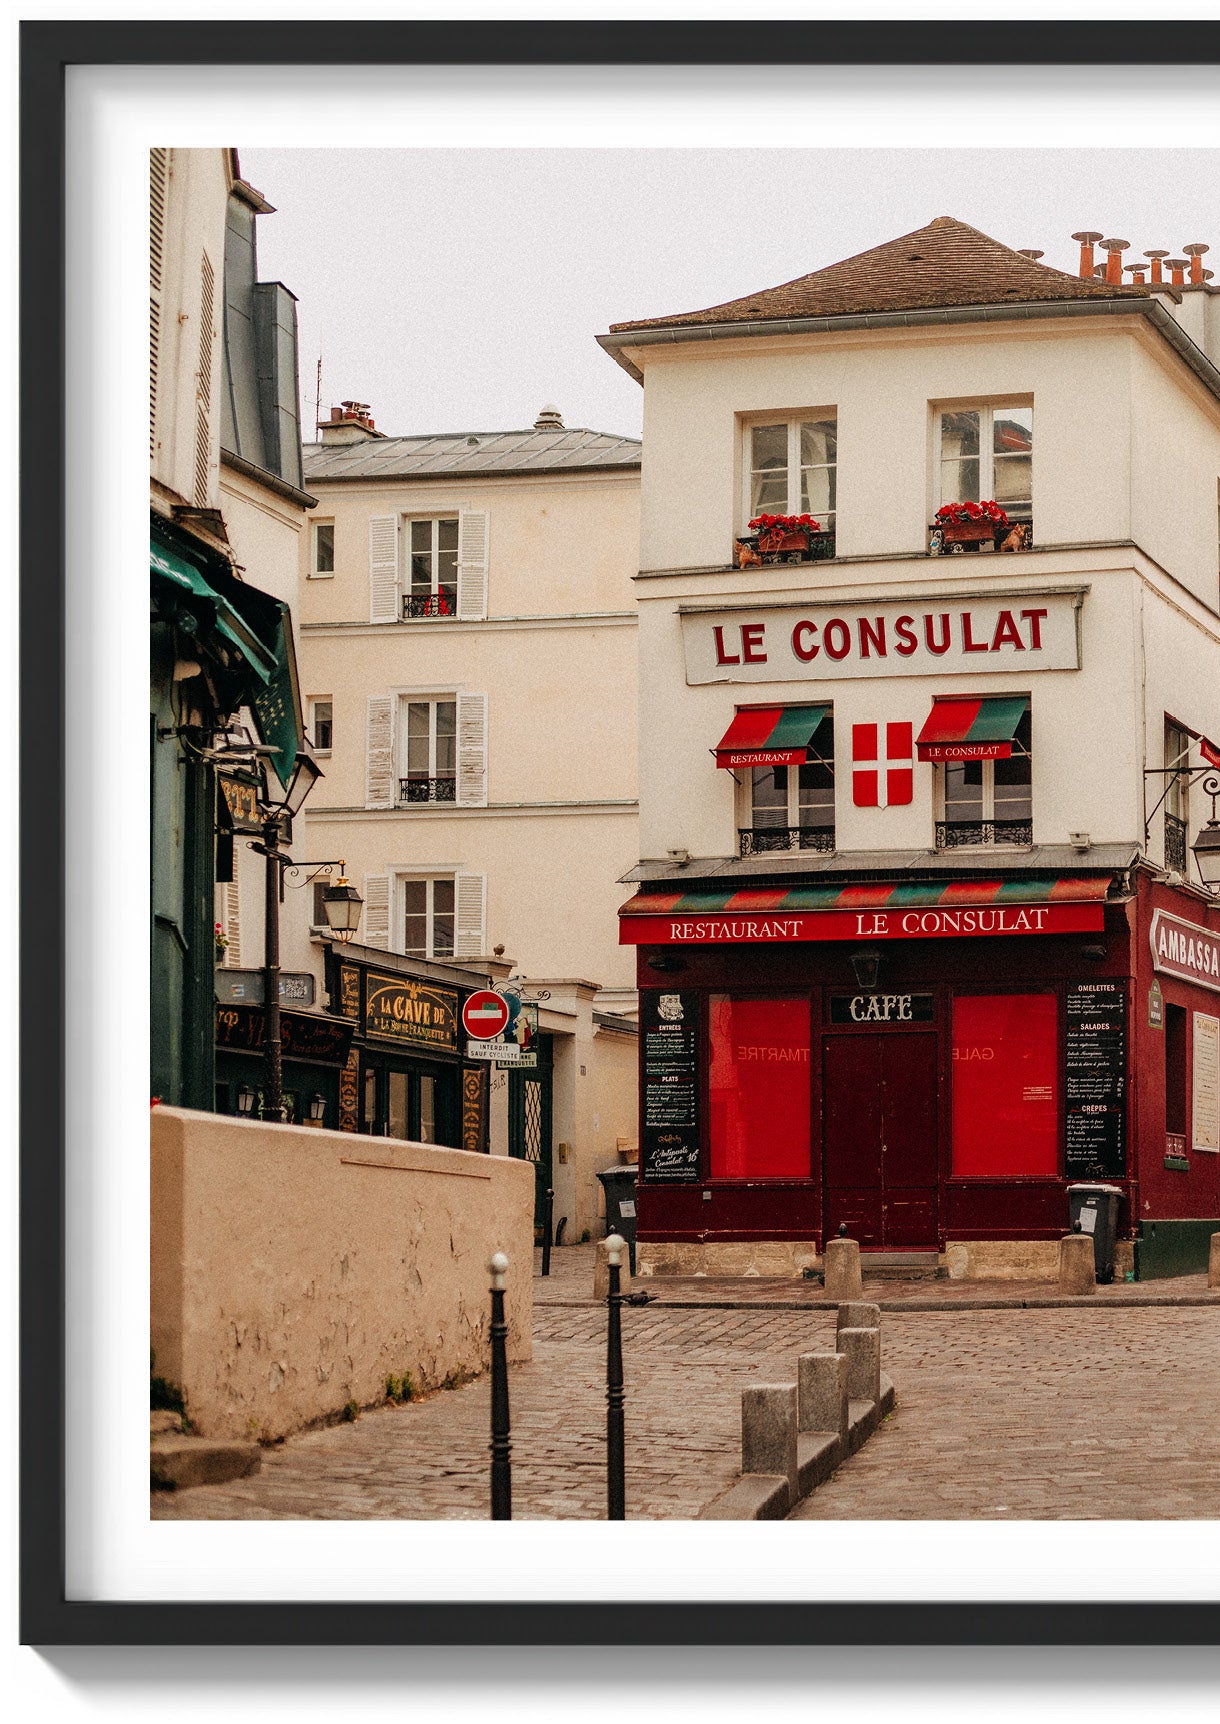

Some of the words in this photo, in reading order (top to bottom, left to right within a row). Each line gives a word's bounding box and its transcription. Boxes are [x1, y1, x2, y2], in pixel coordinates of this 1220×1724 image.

[713, 624, 768, 666] LE
[791, 608, 1049, 662] CONSULAT
[729, 752, 793, 764] RESTAURANT
[928, 748, 942, 758] LE
[945, 746, 1000, 757] CONSULAT
[670, 920, 803, 941] RESTAURANT
[856, 914, 889, 936] LE
[902, 909, 1049, 934] CONSULAT
[1078, 984, 1115, 992] OMELETTES
[381, 996, 392, 1014] LA
[393, 996, 430, 1025] CAVE
[434, 1007, 445, 1025] DE
[850, 995, 912, 1021] CAFE
